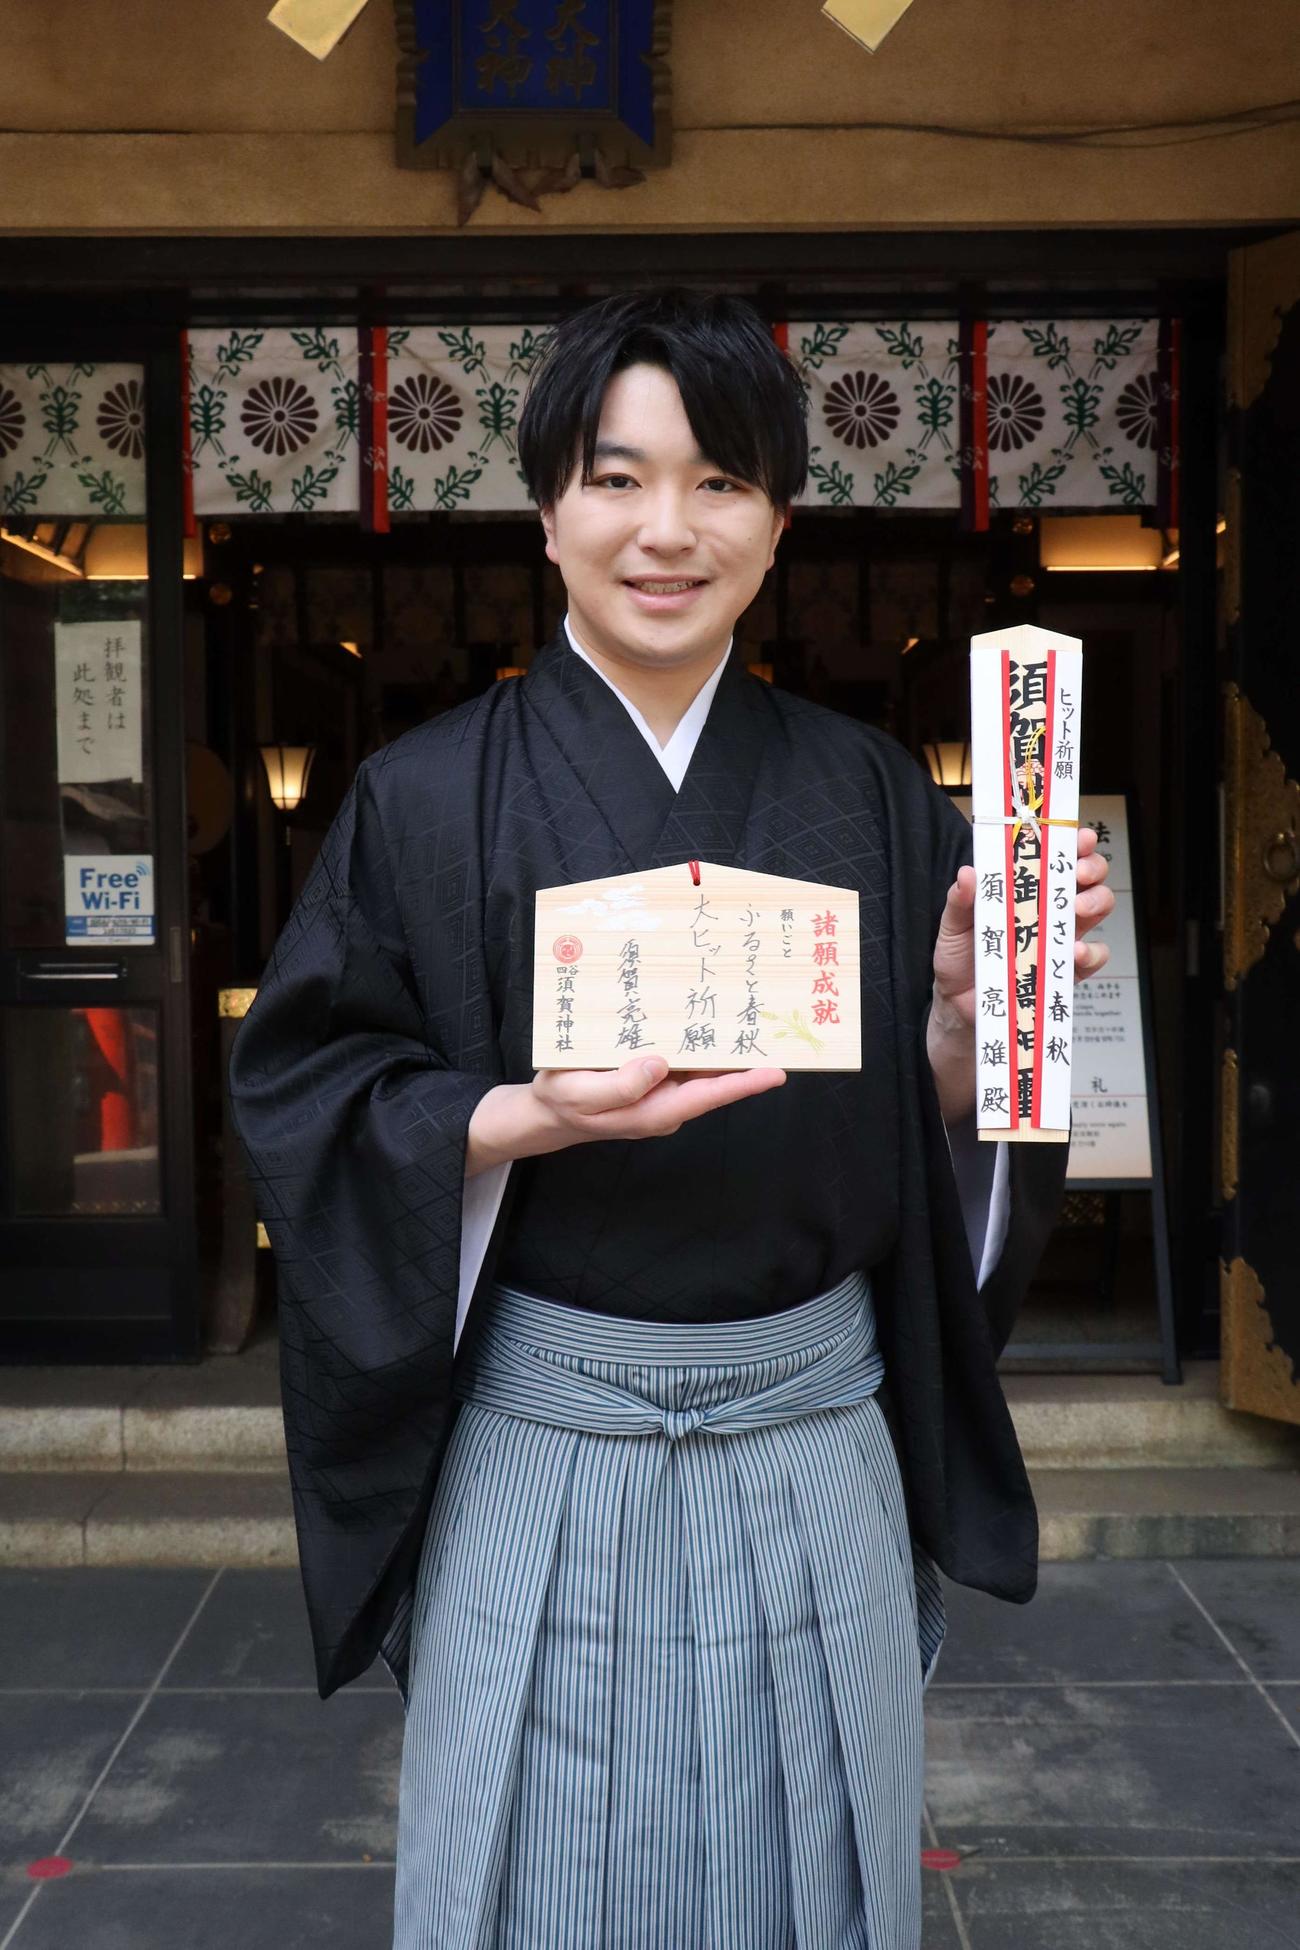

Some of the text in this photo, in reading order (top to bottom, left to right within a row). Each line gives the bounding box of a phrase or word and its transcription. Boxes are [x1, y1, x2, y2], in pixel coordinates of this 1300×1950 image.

[72, 662, 97, 755] 此処まで
[103, 636, 128, 731] 拝観者は
[1053, 687, 1075, 781] ヒット祈願
[79, 867, 139, 889] Free
[81, 891, 140, 910] Wi-Fi
[556, 965, 579, 976] 四谷
[676, 893, 720, 1055] 大ヒット祈願
[730, 903, 768, 1057] ふるさと春秋
[780, 908, 795, 959] 願いごと
[810, 909, 841, 1025] 諸願成就
[1046, 850, 1074, 1066] ふるさと春秋
[555, 976, 576, 1053] 須賀神社
[614, 938, 656, 1051] 須賀亮雄
[979, 871, 1011, 1114] 須賀亮雄殿
